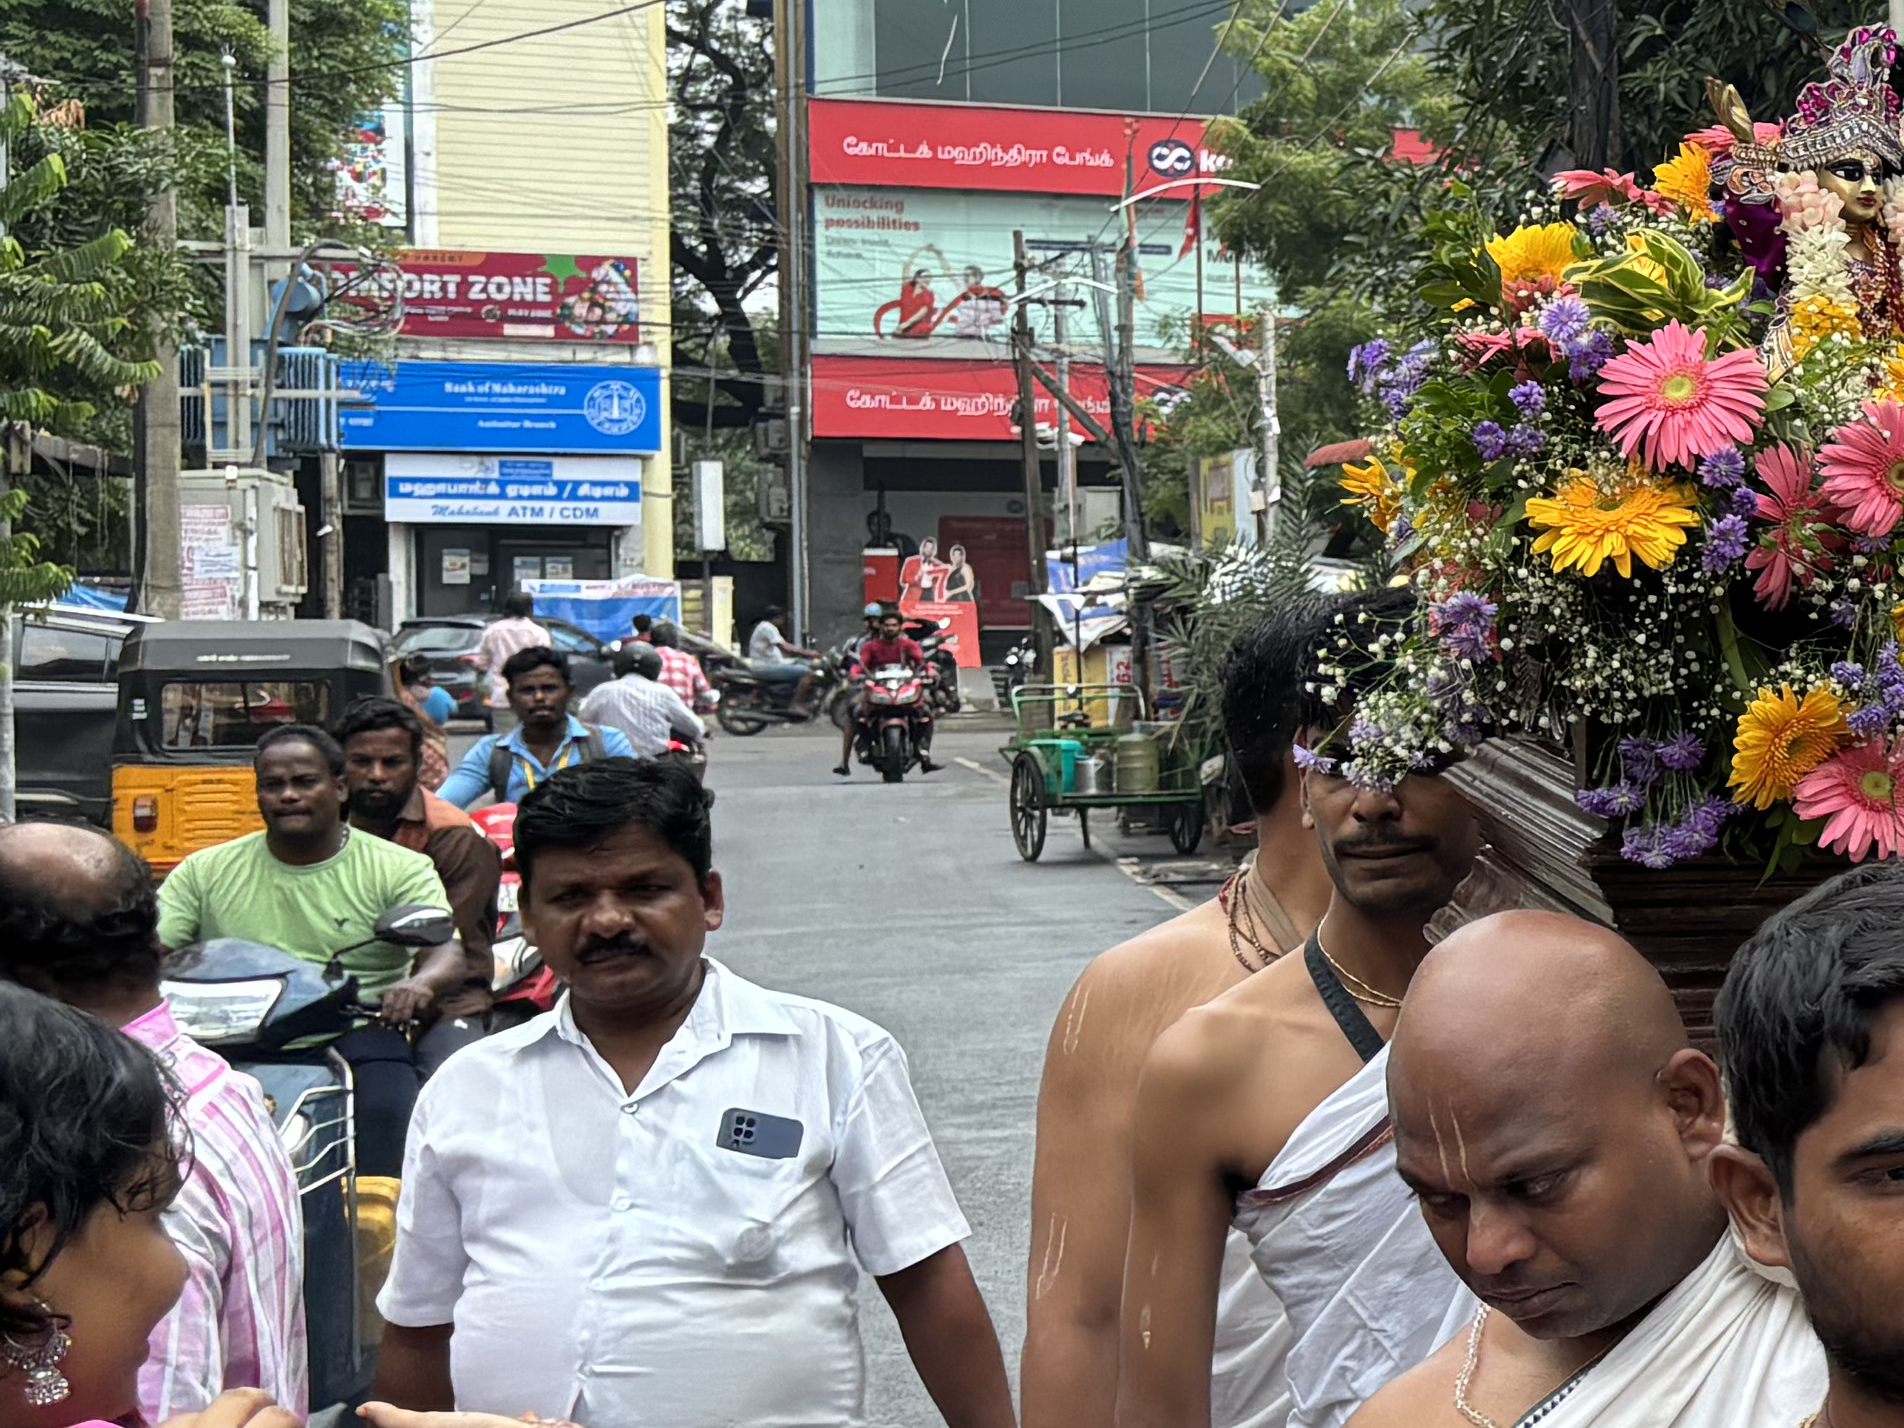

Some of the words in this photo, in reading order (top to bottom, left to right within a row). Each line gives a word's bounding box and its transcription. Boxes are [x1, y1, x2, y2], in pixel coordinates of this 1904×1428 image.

[843, 135, 933, 159] கோட்டக்
[937, 142, 1048, 167] மஹிந்திரா
[467, 275, 553, 302] ZONE
[444, 380, 475, 393] Bank
[477, 380, 490, 394] of
[491, 381, 566, 396] Maharashtra
[507, 506, 544, 519] ATM
[559, 507, 600, 520] CDM
